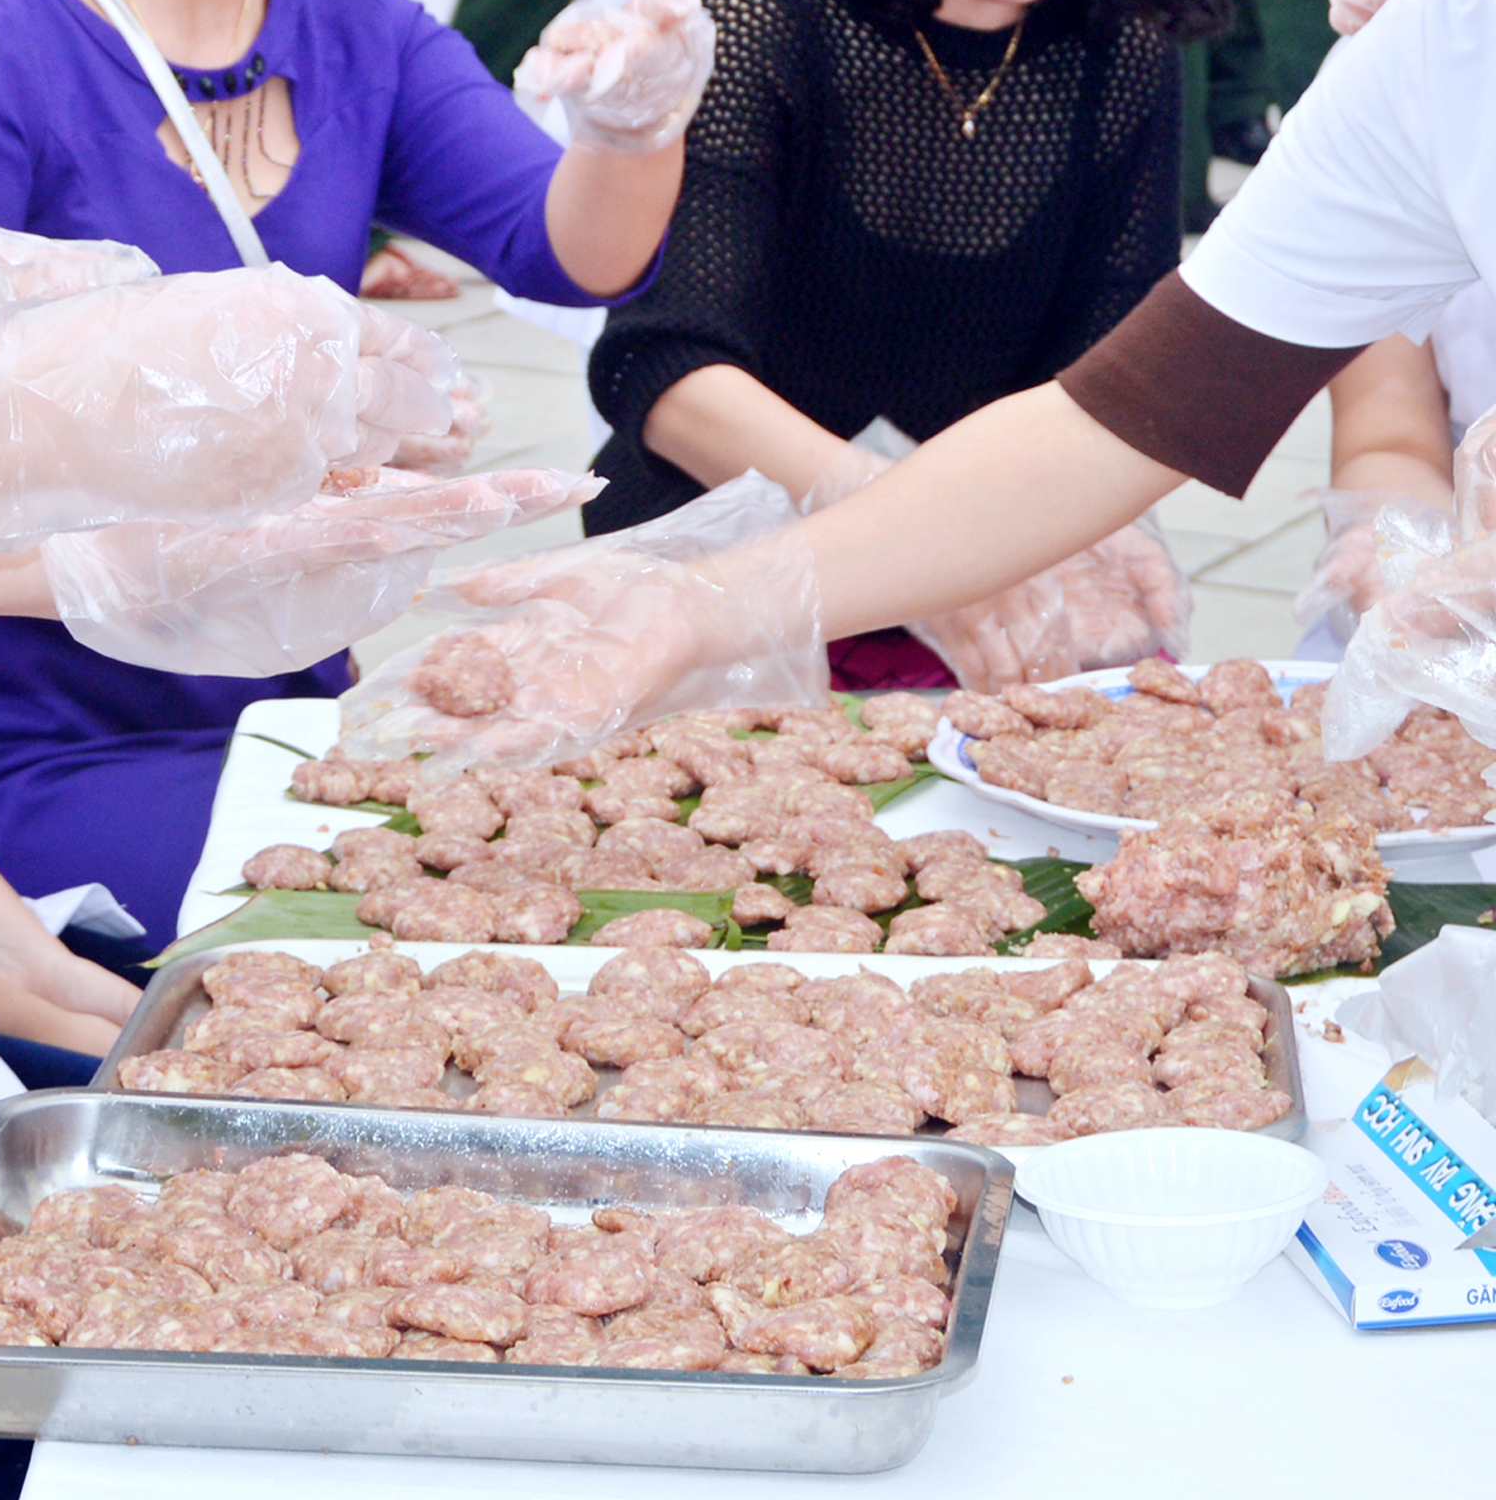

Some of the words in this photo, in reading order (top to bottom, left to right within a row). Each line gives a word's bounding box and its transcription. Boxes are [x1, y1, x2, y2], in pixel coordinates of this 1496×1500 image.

[1362, 1094, 1406, 1138] HỌC
[1389, 1123, 1434, 1166] SINH
[1420, 1154, 1460, 1192] TAY
